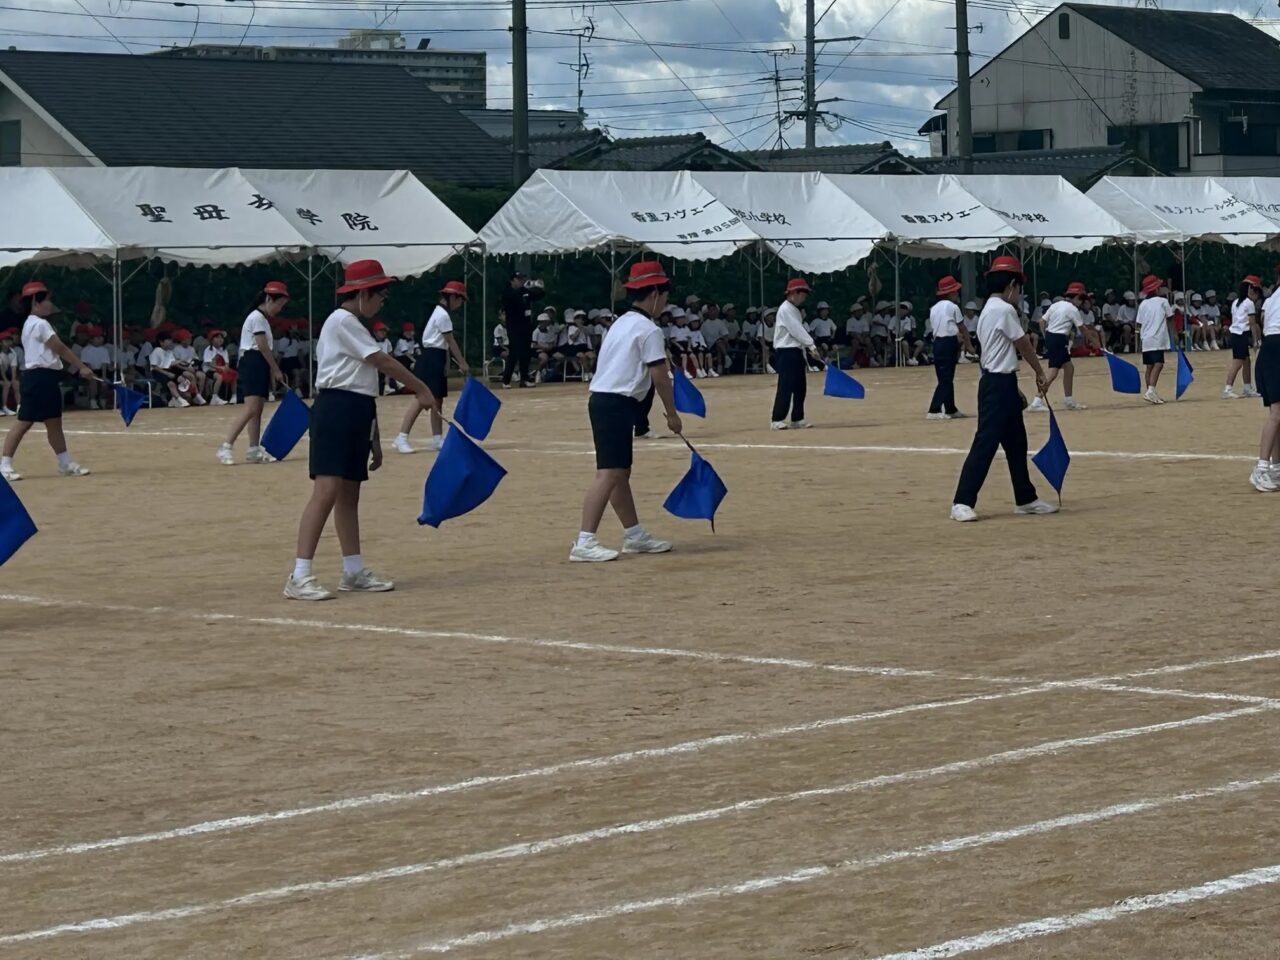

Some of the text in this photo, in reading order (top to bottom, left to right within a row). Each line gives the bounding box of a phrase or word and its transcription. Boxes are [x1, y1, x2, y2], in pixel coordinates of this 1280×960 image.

[136, 193, 379, 231] 聖母女学院
